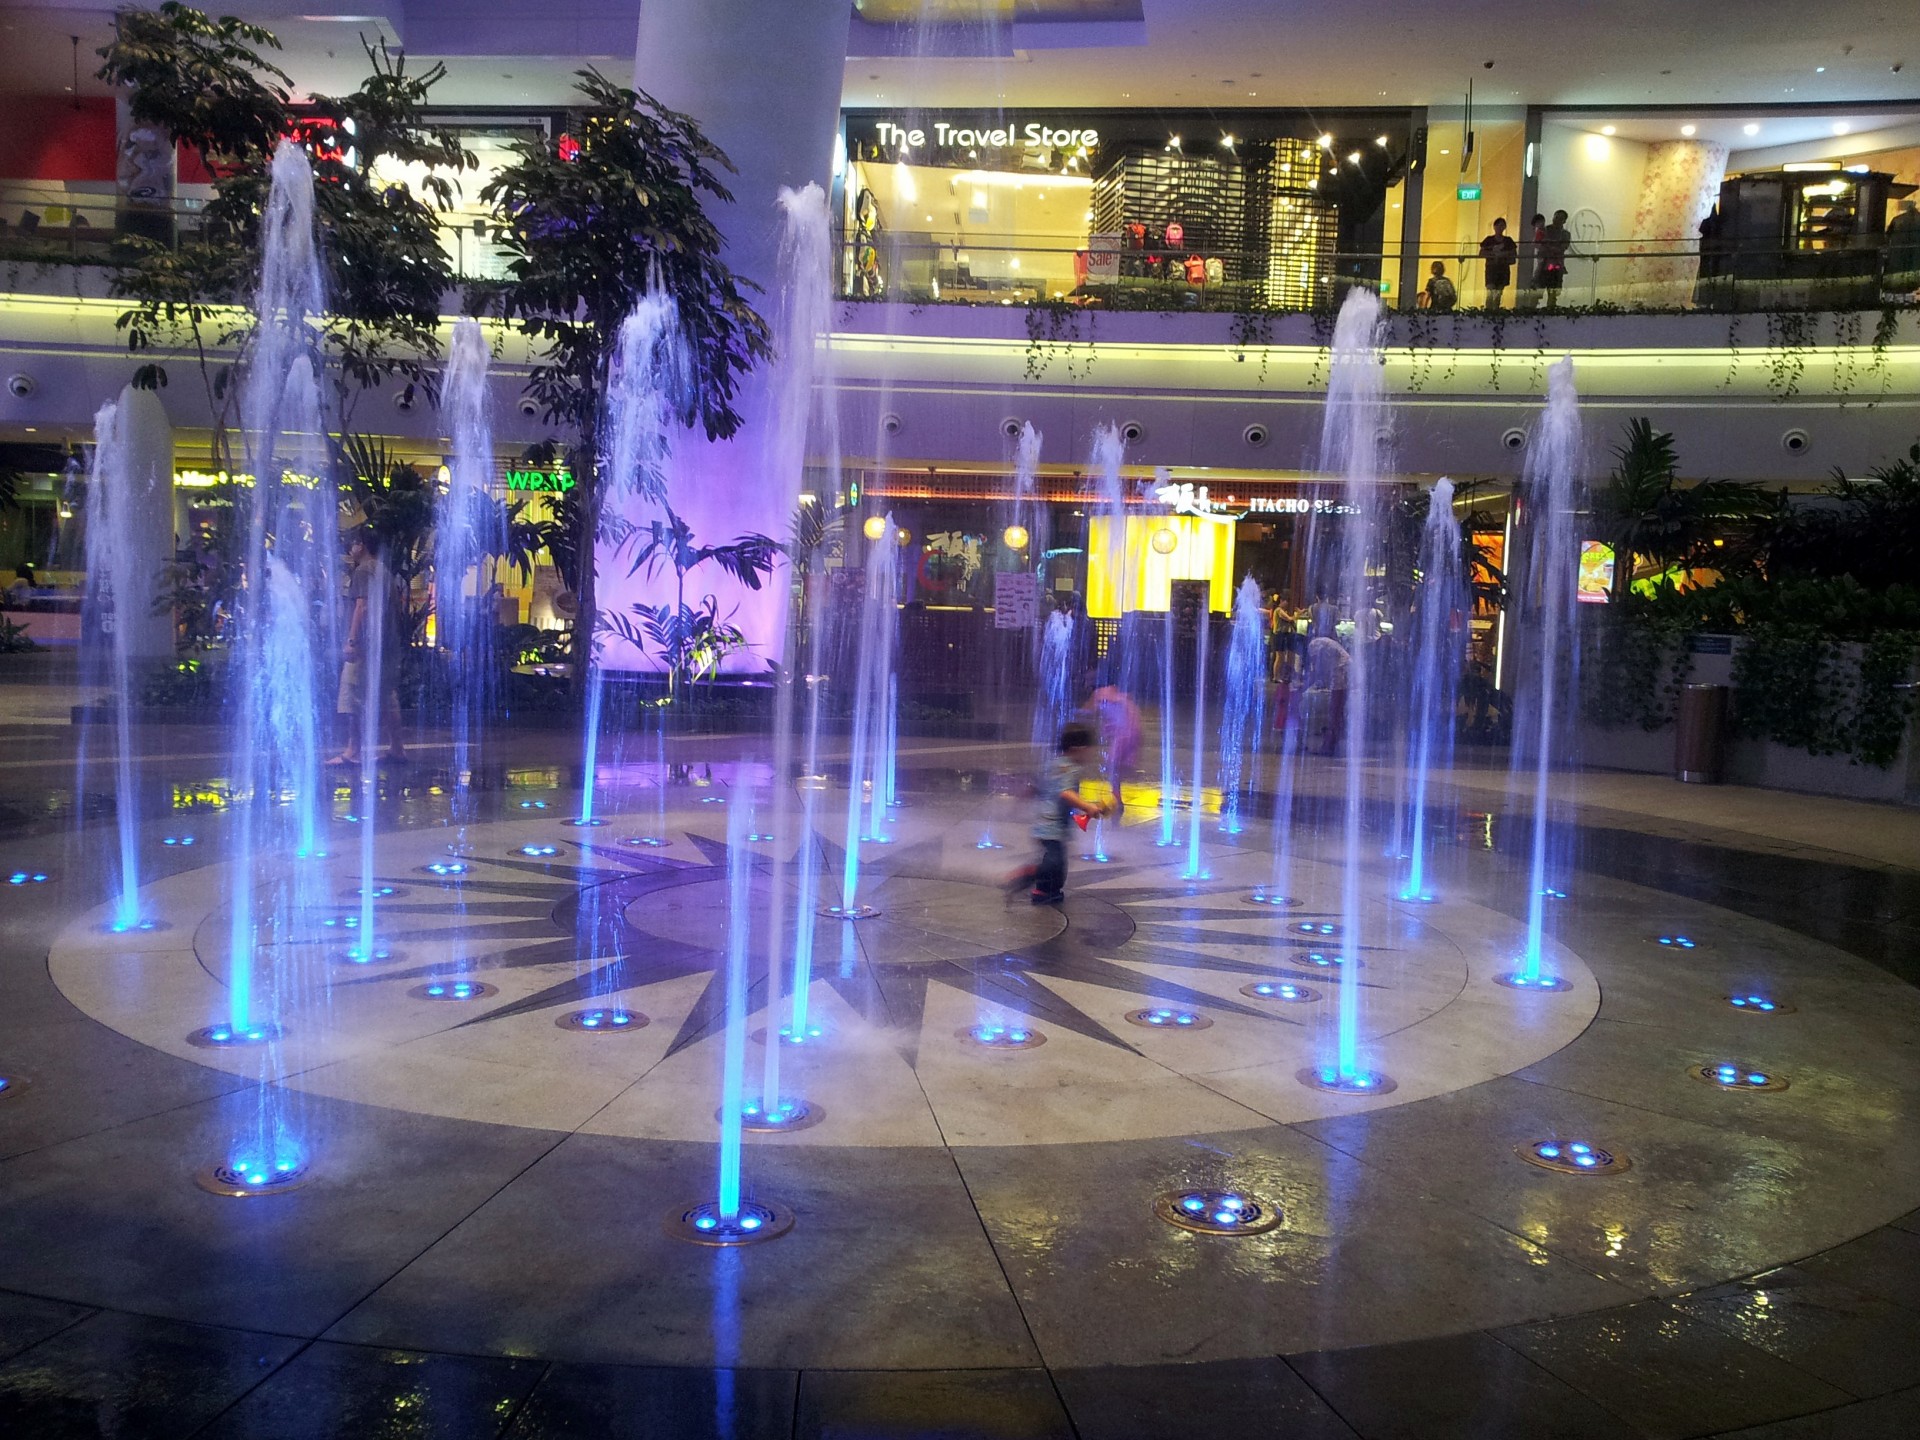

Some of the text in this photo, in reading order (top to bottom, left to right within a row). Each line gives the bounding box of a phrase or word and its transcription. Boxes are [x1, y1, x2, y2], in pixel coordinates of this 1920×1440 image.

[875, 123, 1099, 147] The Travel Store
[1461, 190, 1477, 199] EXIT
[1088, 251, 1112, 267] Sale
[1250, 498, 1309, 512] ITACHO
